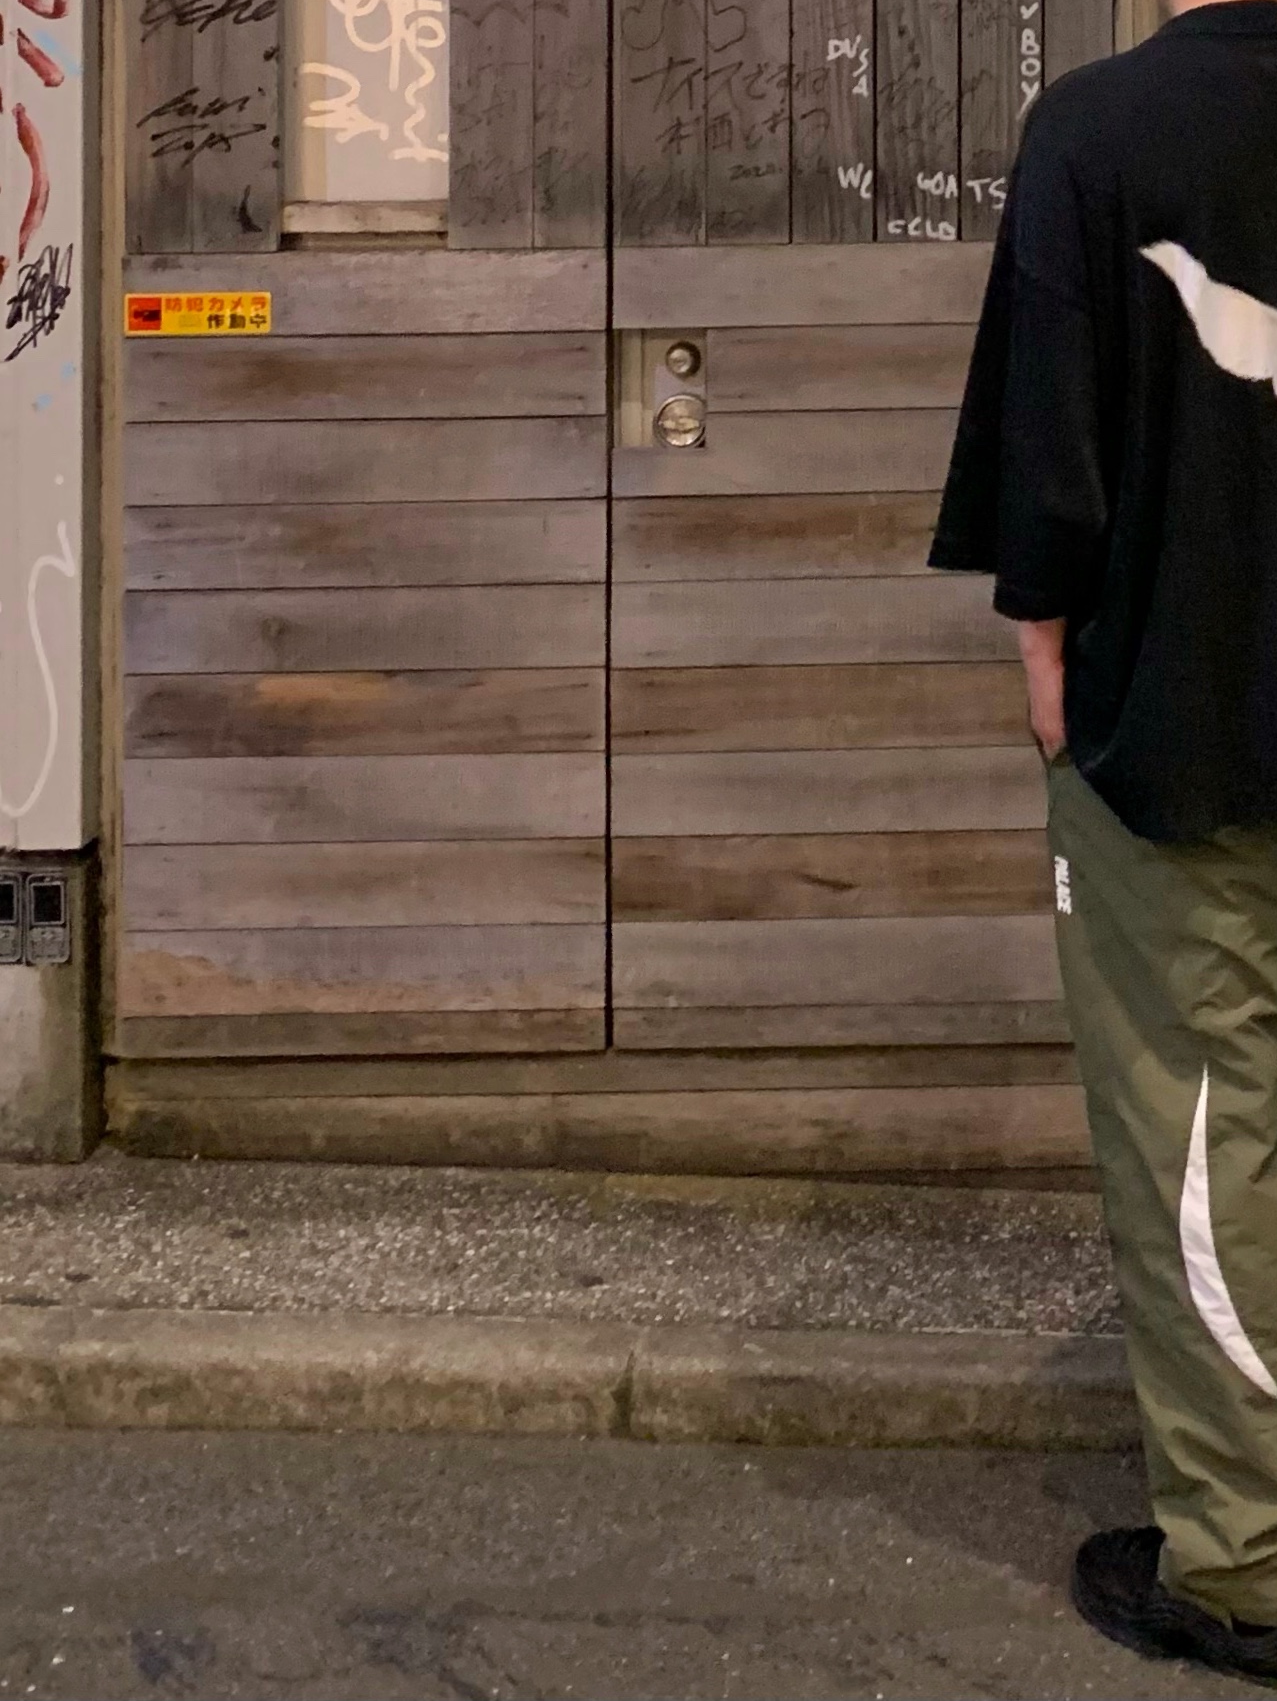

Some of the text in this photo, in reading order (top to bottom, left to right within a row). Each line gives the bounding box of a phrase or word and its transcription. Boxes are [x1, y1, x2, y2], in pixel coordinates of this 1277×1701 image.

[164, 297, 268, 313] 防犯カメラ
